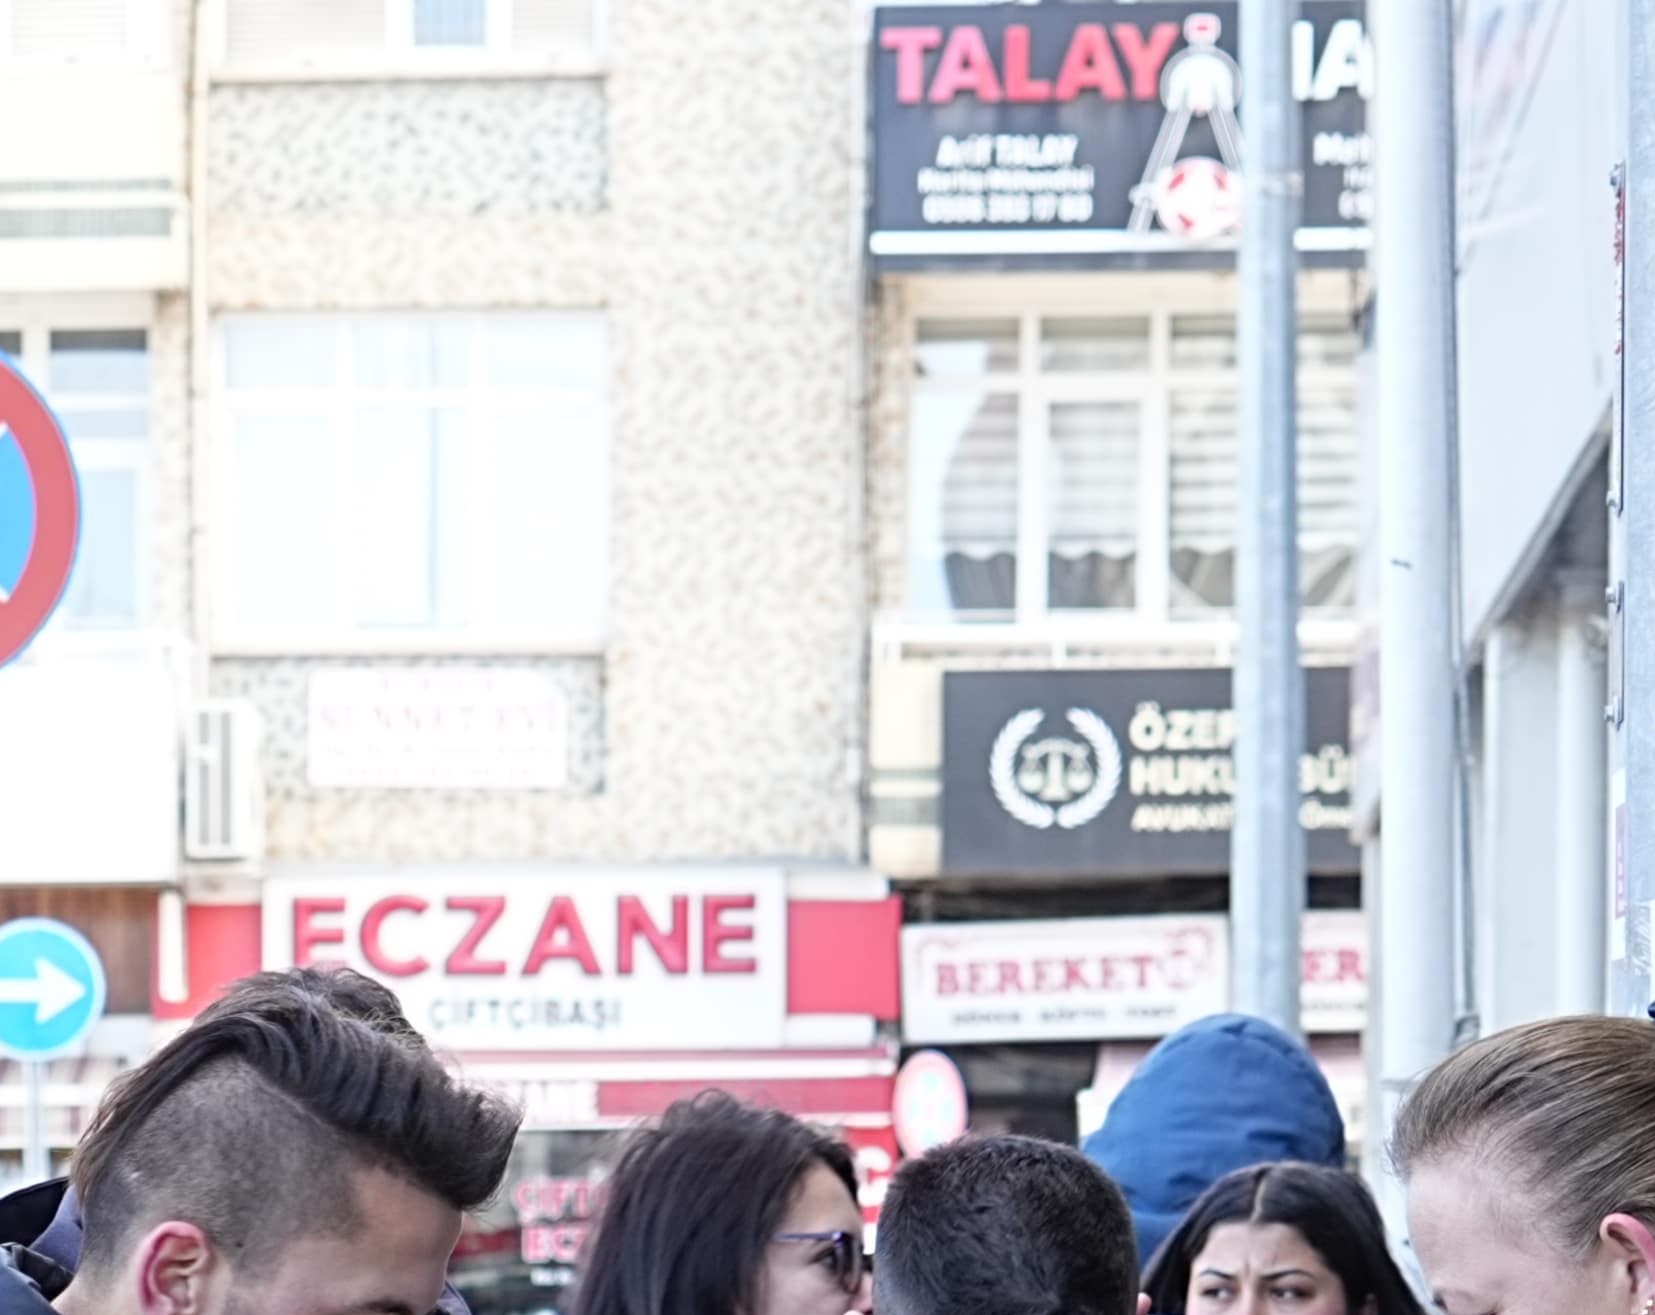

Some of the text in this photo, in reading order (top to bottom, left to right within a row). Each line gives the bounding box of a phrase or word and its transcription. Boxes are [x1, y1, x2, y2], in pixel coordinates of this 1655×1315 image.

[880, 23, 1178, 103] TALAY
[292, 894, 758, 978] ECZANE
[933, 953, 1159, 998] BEREKET
